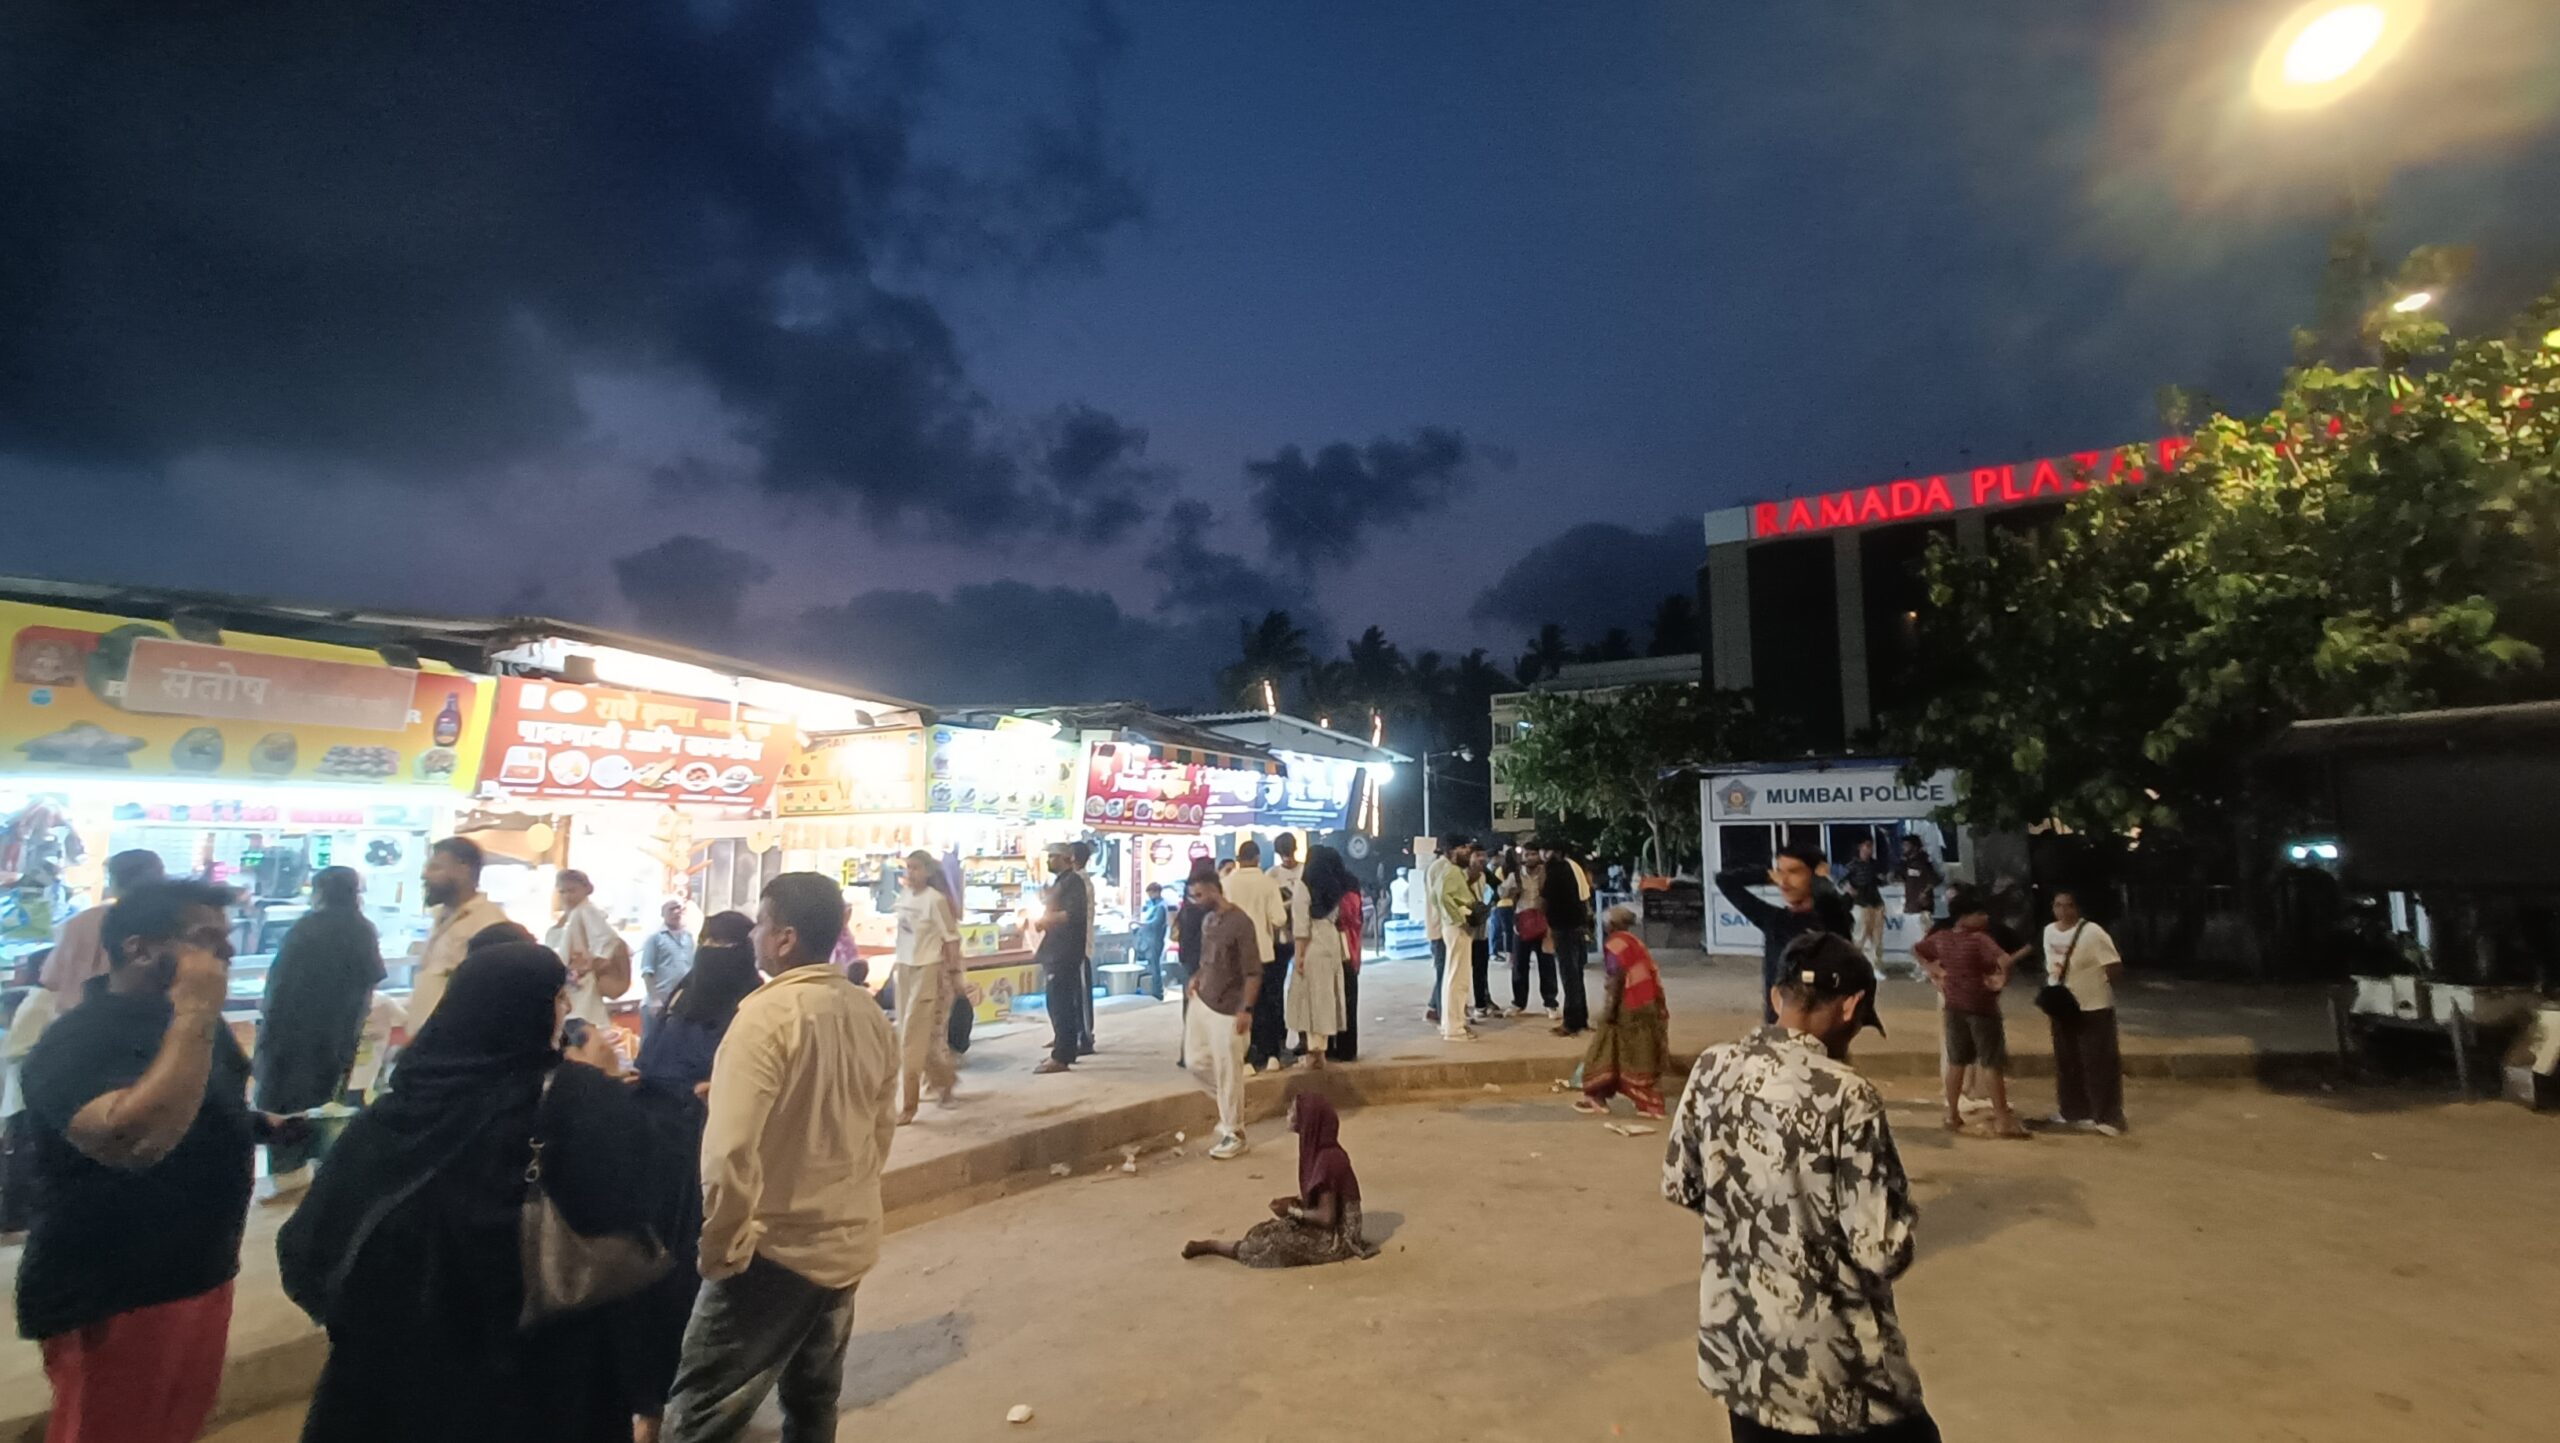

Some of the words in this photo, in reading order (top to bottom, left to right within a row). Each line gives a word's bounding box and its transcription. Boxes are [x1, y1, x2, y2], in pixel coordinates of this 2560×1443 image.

[1756, 475, 1955, 537] RAMADA
[1766, 786, 1853, 804] MUMBAI
[1860, 784, 1944, 802] POLICE
